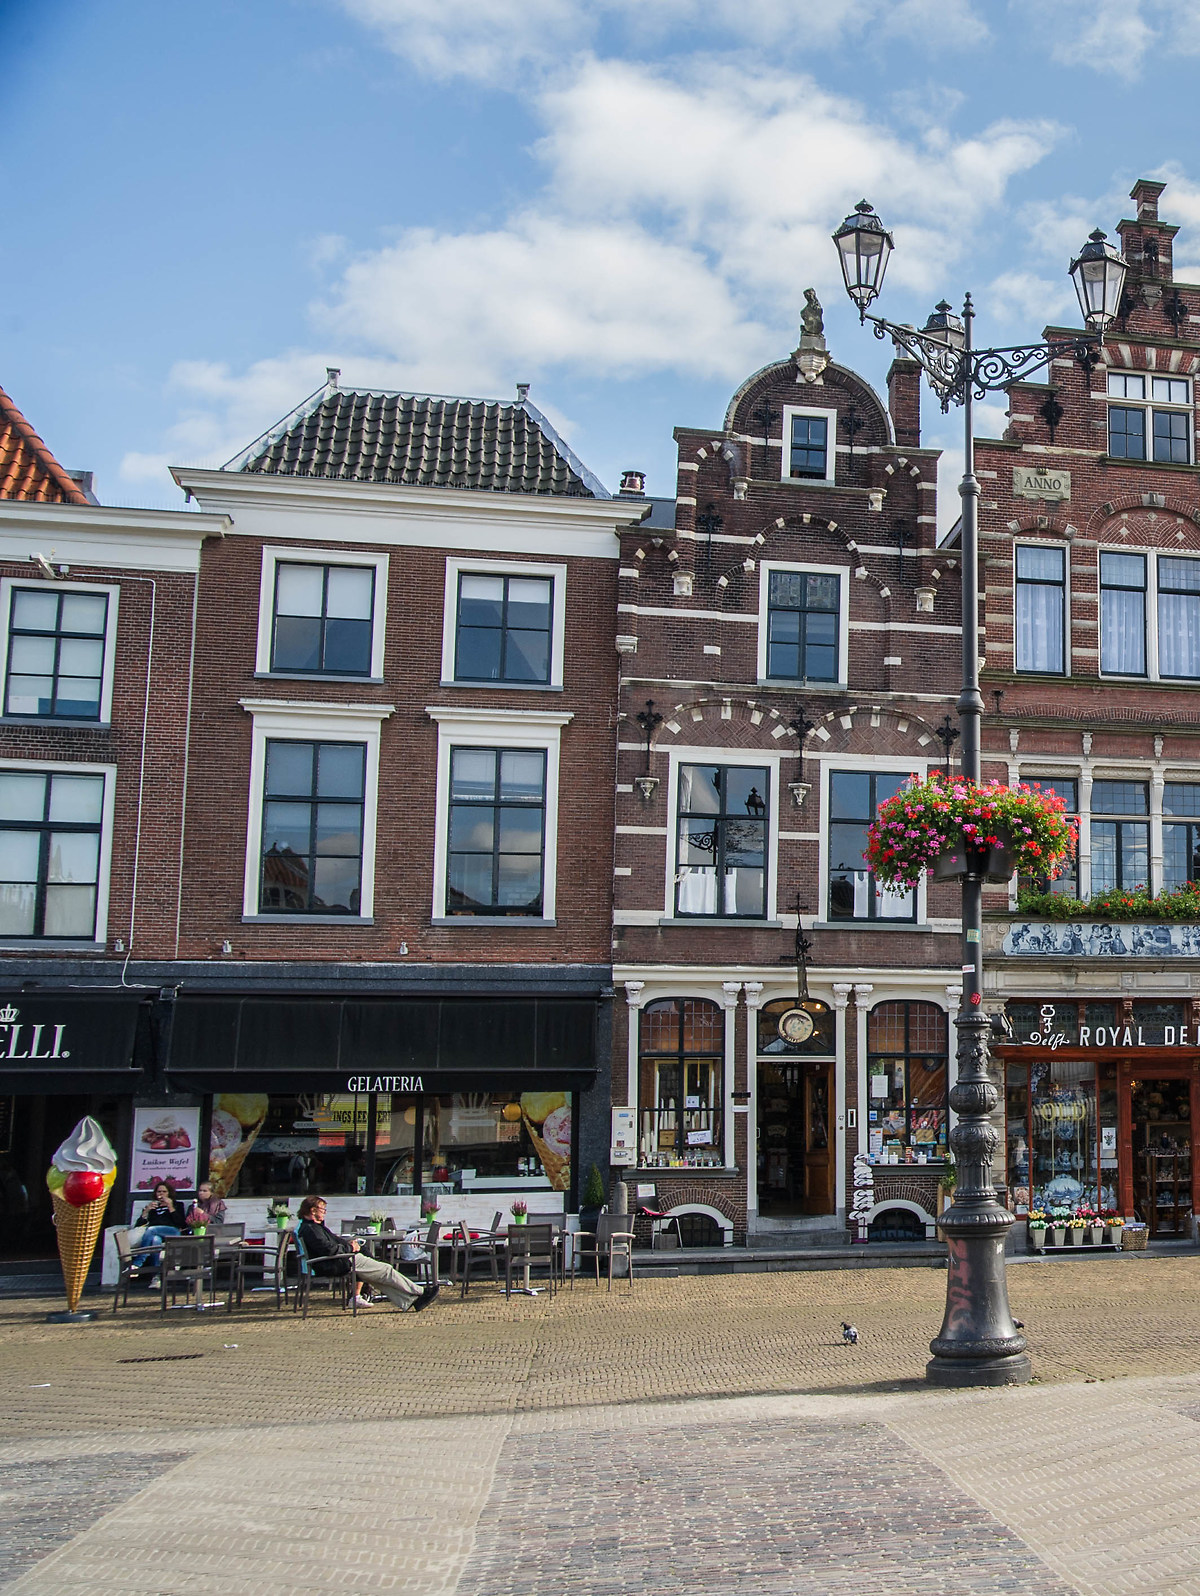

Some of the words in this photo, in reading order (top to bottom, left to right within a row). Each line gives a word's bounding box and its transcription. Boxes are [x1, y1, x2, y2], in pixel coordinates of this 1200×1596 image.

[1024, 476, 1062, 490] ANNO
[1022, 1031, 1070, 1051] Delft
[1079, 1026, 1146, 1047] ROYAL
[347, 1076, 424, 1092] GELATERIA
[1041, 1102, 1086, 1121] OLD
